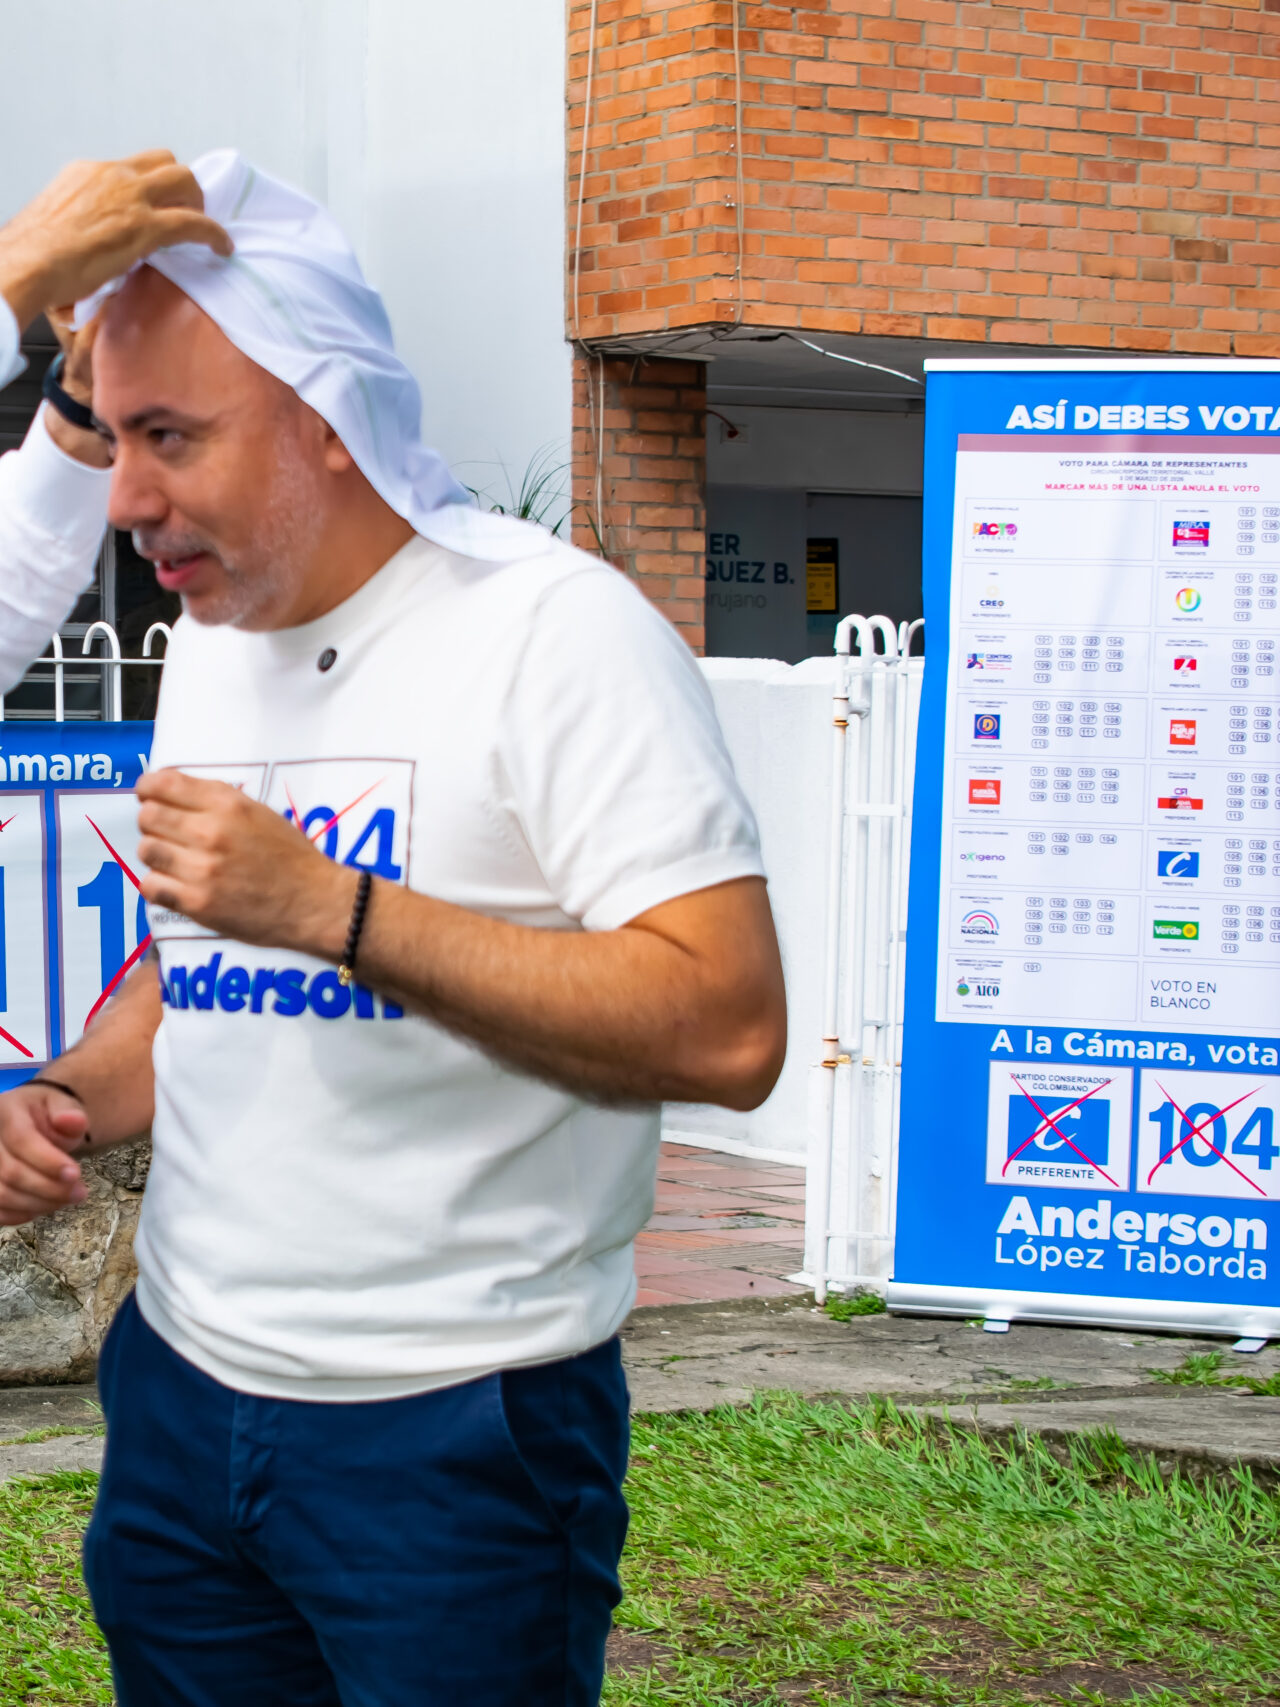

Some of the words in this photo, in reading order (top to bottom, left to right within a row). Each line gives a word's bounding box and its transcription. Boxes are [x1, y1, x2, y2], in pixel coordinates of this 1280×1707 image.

[1006, 400, 1069, 430] ASÍ
[1073, 404, 1190, 431] DEBES
[774, 562, 795, 584] B.
[284, 806, 402, 880] 04
[1150, 979, 1192, 992] VOTO
[1197, 982, 1217, 993] EN
[1150, 996, 1211, 1010] BLANCO
[990, 1029, 1014, 1053] A
[1025, 1030, 1053, 1055] la
[1063, 1031, 1196, 1067] Cámara,
[1207, 1042, 1278, 1067] vota
[1010, 1072, 1046, 1082] PARTIDO
[1048, 1074, 1112, 1085] CONSERVADOR
[1032, 1082, 1089, 1093] COLOMBIANO
[1149, 1101, 1280, 1171] 104
[1017, 1165, 1095, 1180] PREFERENTE
[997, 1195, 1268, 1251] Anderson
[994, 1237, 1105, 1272] López
[1118, 1243, 1268, 1281] Taborda
